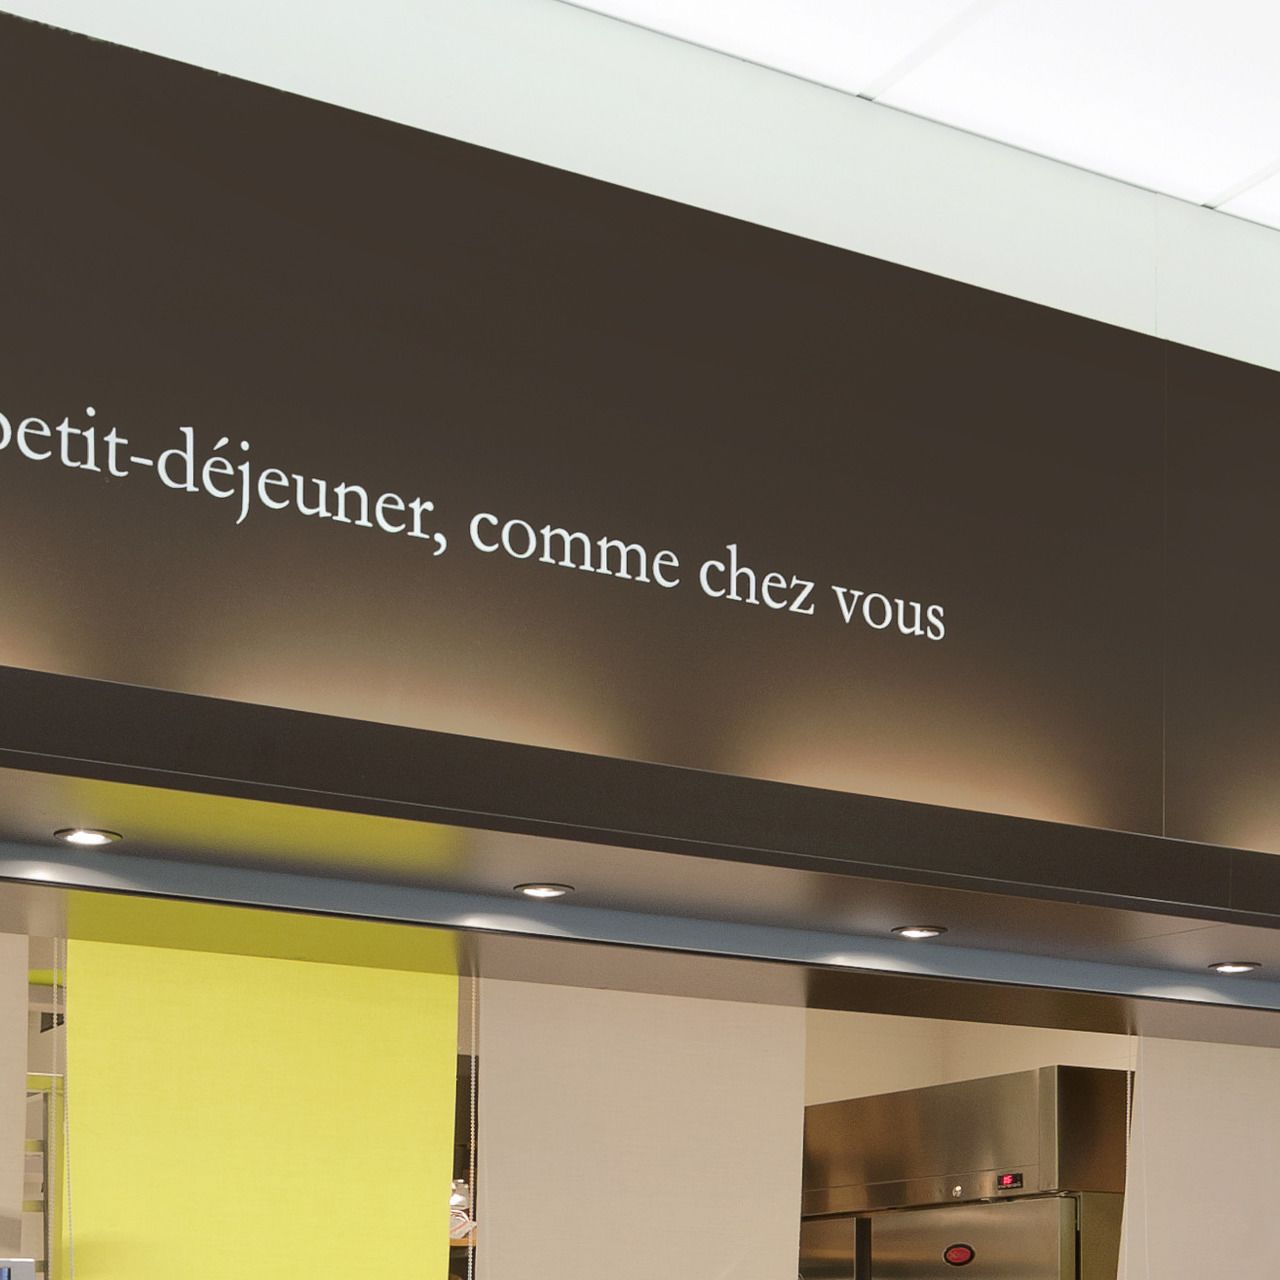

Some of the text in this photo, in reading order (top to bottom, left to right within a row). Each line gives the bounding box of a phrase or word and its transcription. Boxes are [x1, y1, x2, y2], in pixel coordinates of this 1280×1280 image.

[469, 513, 680, 588] comme
[699, 543, 815, 615] chez
[831, 585, 946, 641] vous
